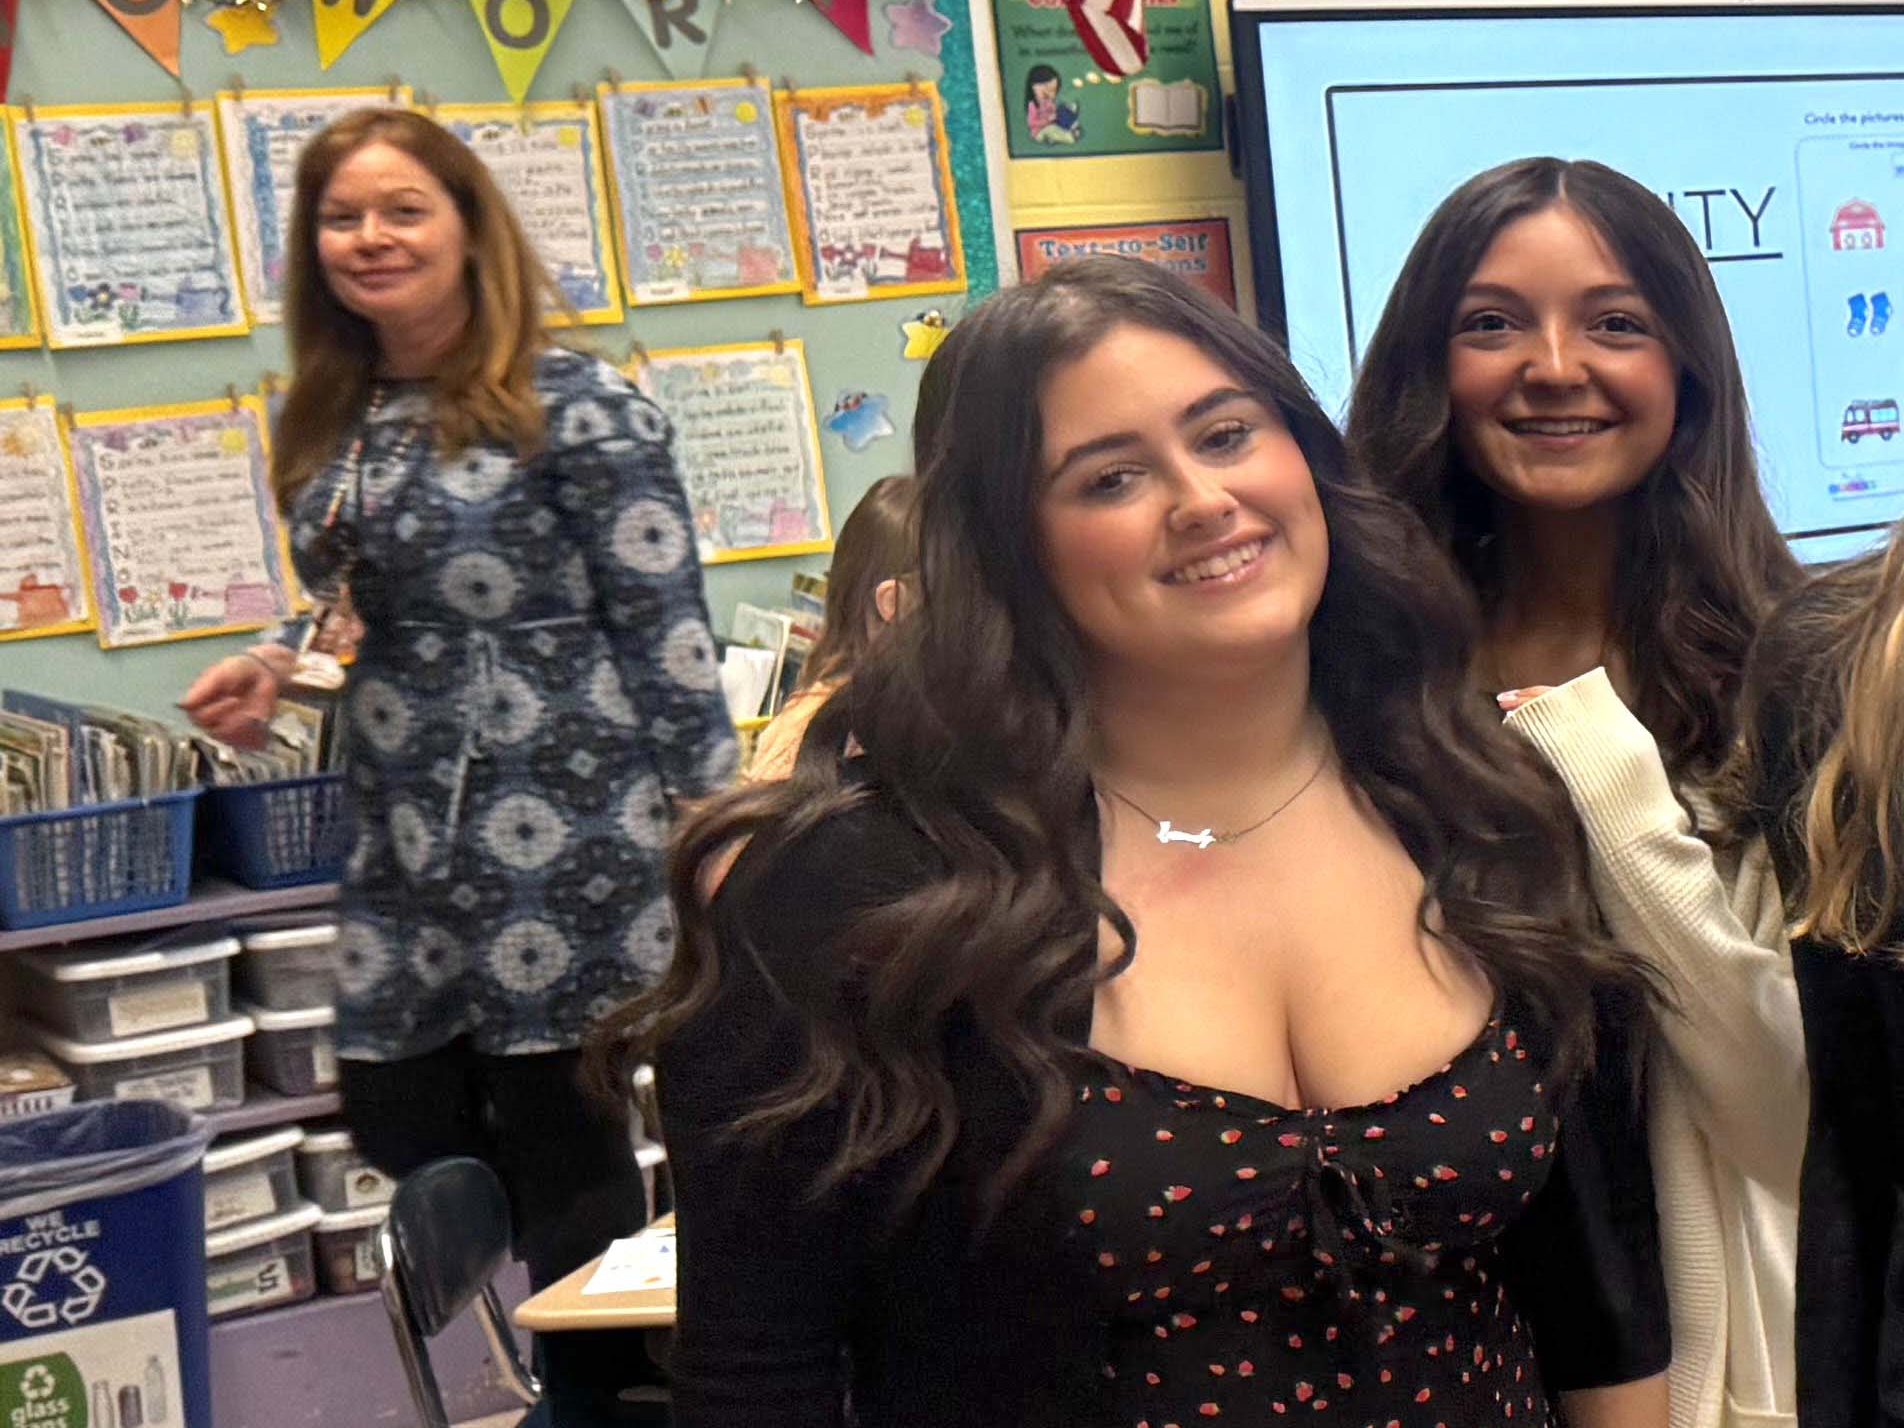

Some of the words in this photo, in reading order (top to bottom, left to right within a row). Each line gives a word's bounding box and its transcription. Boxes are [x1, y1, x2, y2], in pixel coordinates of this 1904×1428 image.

[1805, 111, 1835, 124] Circle
[1840, 110, 1856, 123] the
[1861, 110, 1904, 125] pictures
[1668, 187, 1776, 250] TY
[27, 1210, 63, 1230] WE
[0, 1221, 99, 1255] RECYCLE
[11, 1398, 69, 1422] glass
